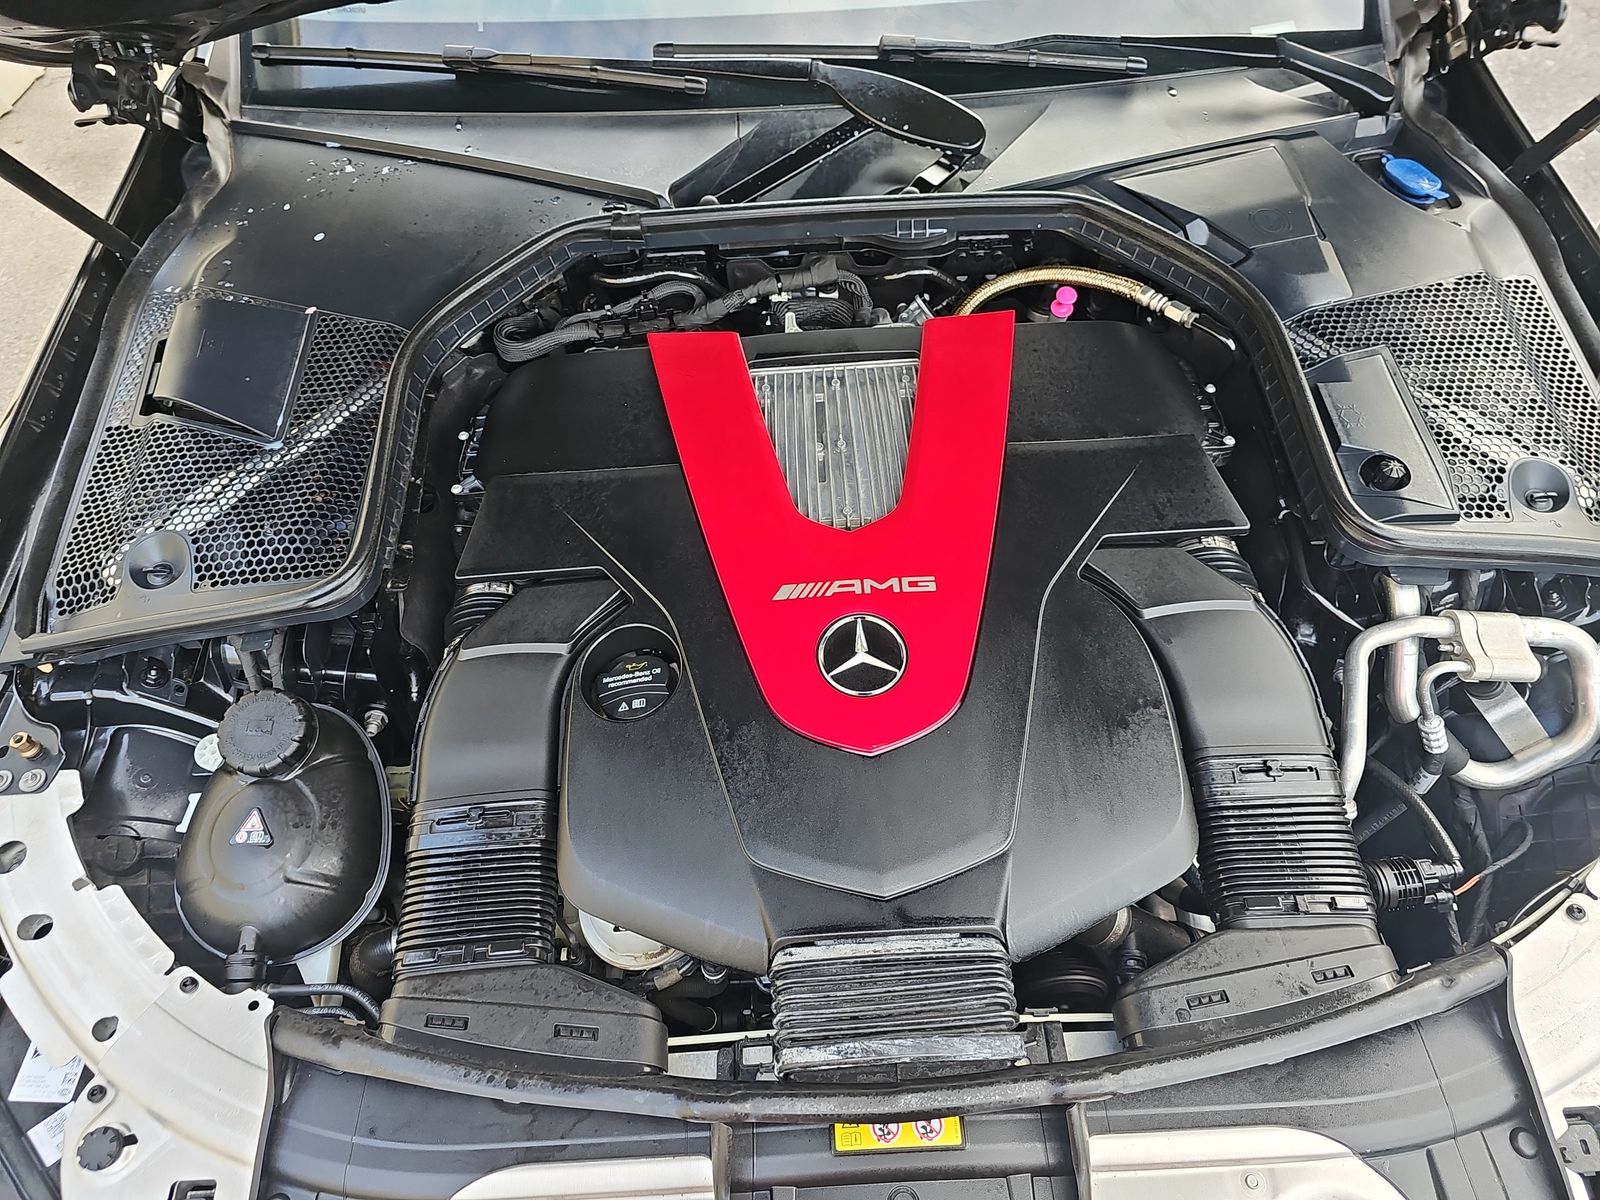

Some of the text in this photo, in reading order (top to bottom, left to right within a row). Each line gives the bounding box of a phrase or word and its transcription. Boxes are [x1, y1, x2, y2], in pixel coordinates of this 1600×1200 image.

[824, 575, 937, 597] AMG
[602, 667, 662, 684] Mercedes-Benz Oil
[607, 675, 653, 688] recommended
